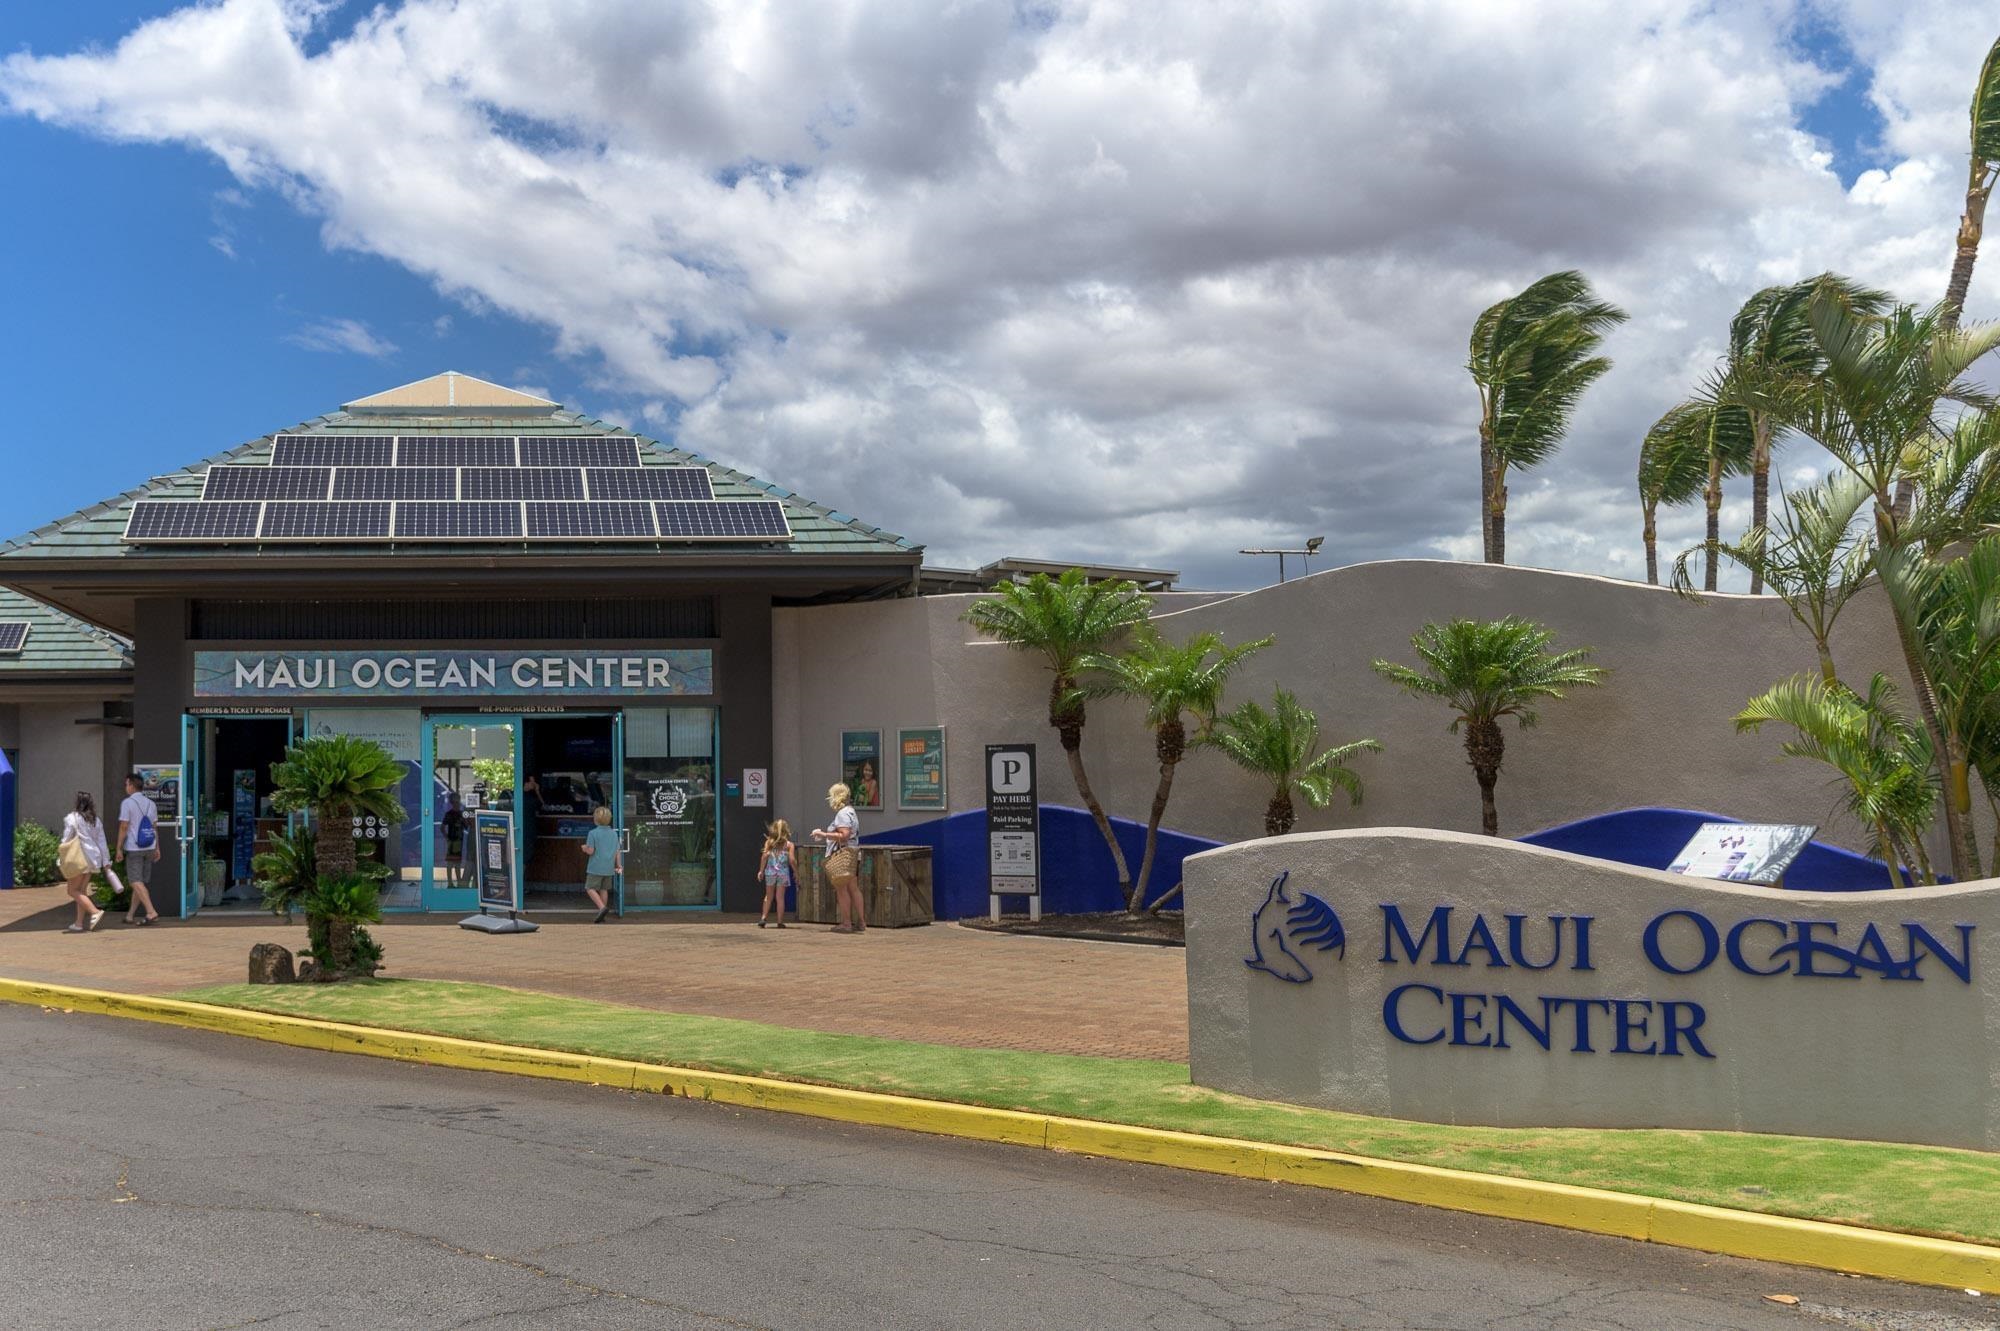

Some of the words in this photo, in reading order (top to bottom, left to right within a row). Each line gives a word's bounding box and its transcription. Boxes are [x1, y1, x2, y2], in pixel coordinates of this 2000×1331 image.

[235, 658, 336, 689] MAUI
[351, 658, 496, 689] OCEAN
[511, 657, 671, 688] CENTER
[1001, 760, 1022, 786] P
[993, 795, 1008, 803] PAY
[1009, 795, 1032, 803] HERE
[1007, 815, 1033, 825] Parking
[1378, 903, 1596, 971] MAUI
[1643, 910, 1977, 984] OCEAN
[1383, 983, 1716, 1058] CENTER
